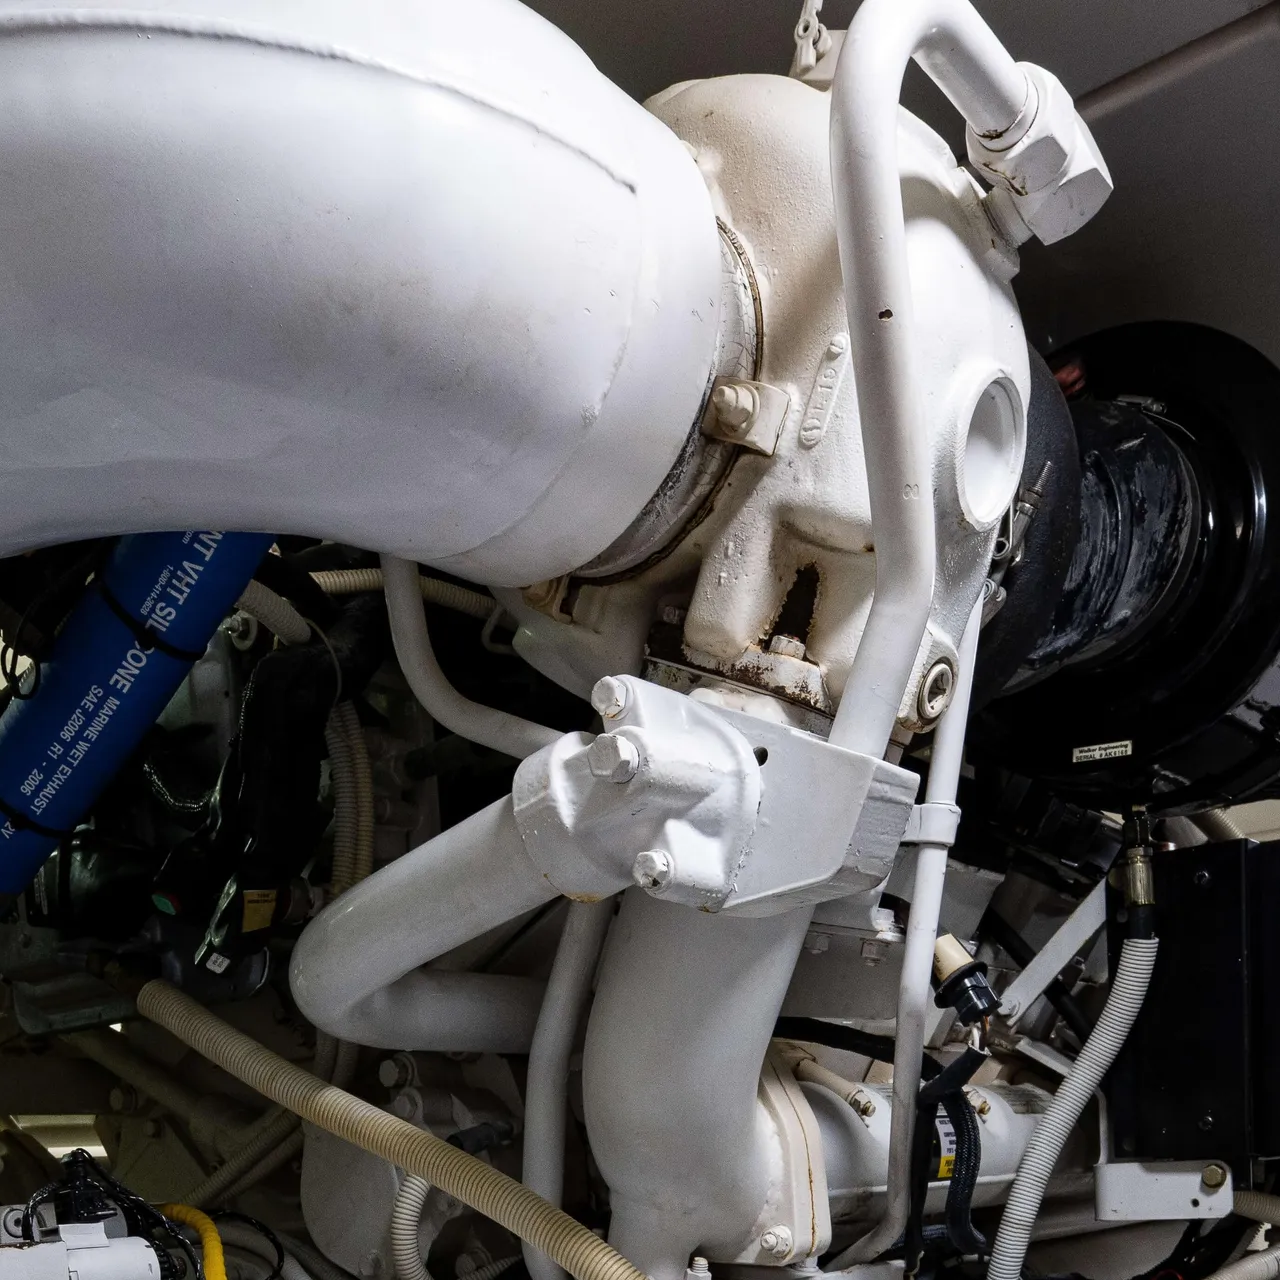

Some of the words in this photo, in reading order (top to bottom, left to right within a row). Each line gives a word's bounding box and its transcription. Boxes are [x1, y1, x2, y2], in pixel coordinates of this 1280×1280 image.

[167, 560, 204, 605] VHT
[80, 684, 104, 712] SAE
[59, 708, 86, 742] J2006
[83, 696, 121, 742] MARINE
[47, 742, 64, 760] R1
[67, 740, 91, 767] WET
[1098, 743, 1129, 752] Engineering
[20, 768, 44, 796] 2006
[30, 764, 72, 815] EXHAUST
